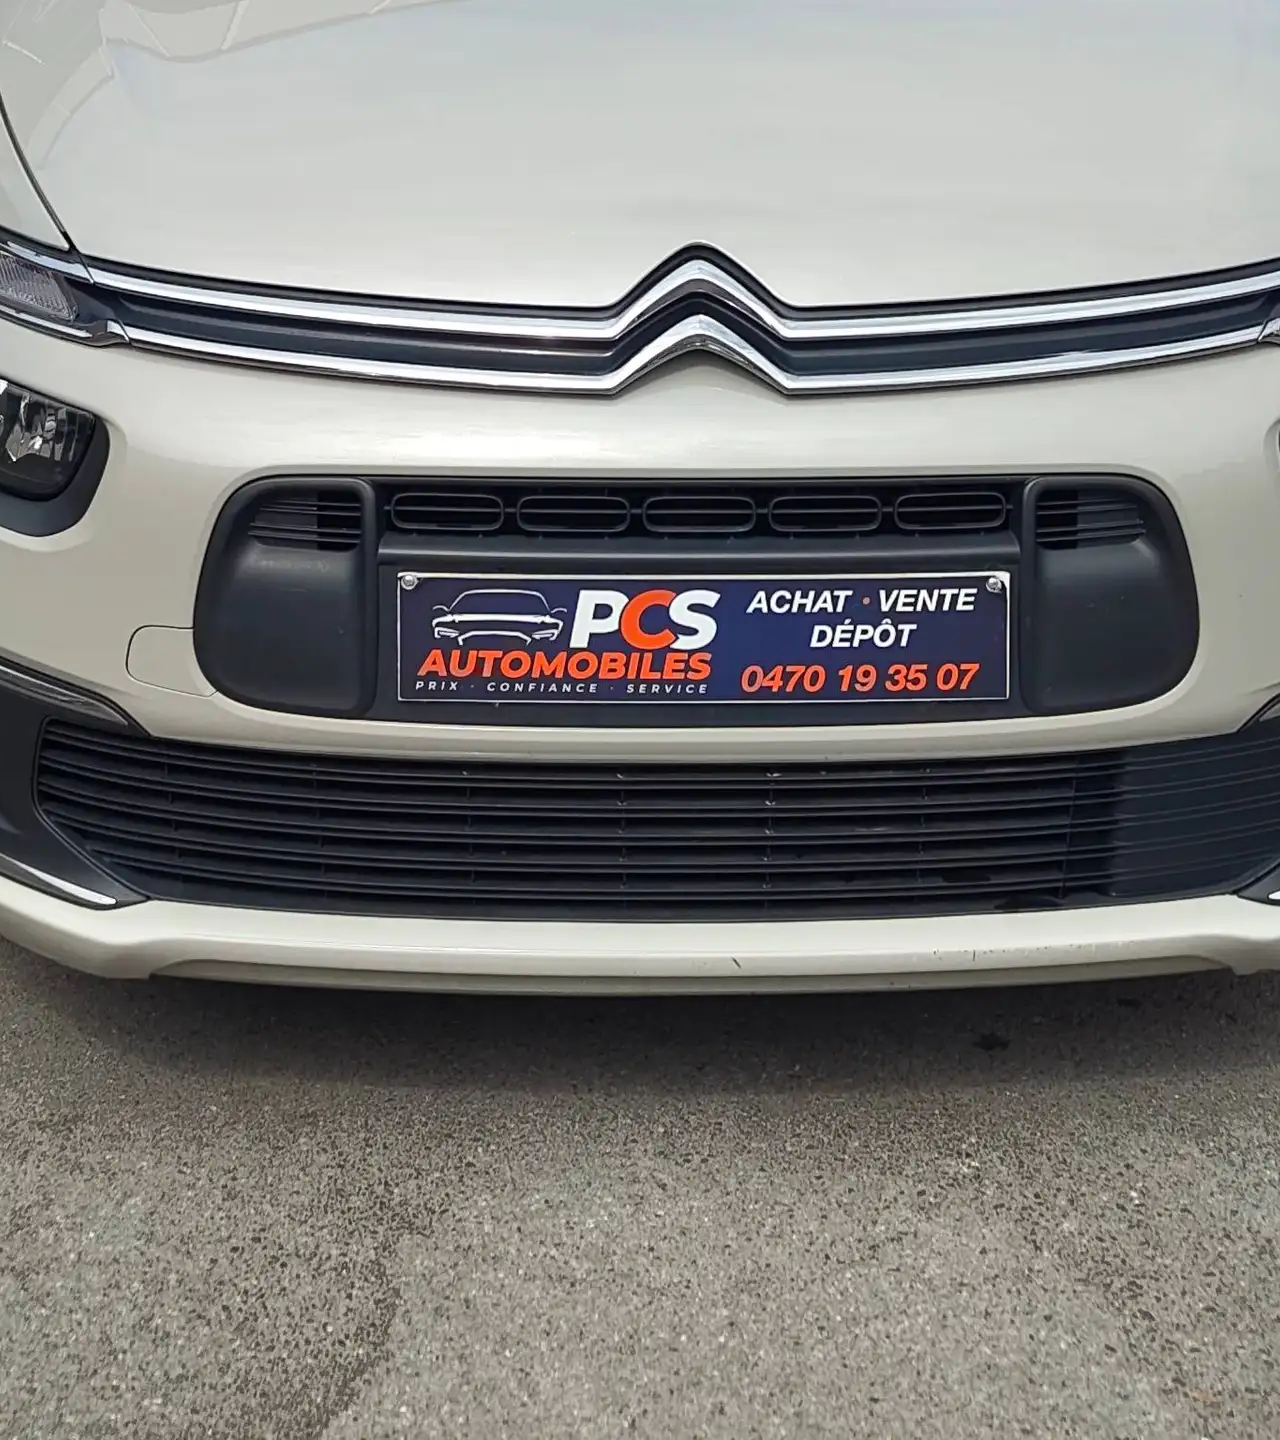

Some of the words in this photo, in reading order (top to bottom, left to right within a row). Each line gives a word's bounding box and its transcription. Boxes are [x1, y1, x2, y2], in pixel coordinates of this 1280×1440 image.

[746, 590, 850, 613] ACHAT
[880, 588, 977, 611] VENTE
[570, 590, 720, 650] PCS
[810, 619, 917, 647] DÉPÔT
[417, 650, 710, 680] AUTOMOBILES
[740, 665, 826, 692] 0470
[838, 665, 876, 690] 19
[886, 664, 927, 691] 35
[936, 663, 979, 690] 07
[416, 681, 457, 690] PRIX
[487, 682, 597, 692] CONFIANCE
[627, 684, 707, 693] SERVICE
